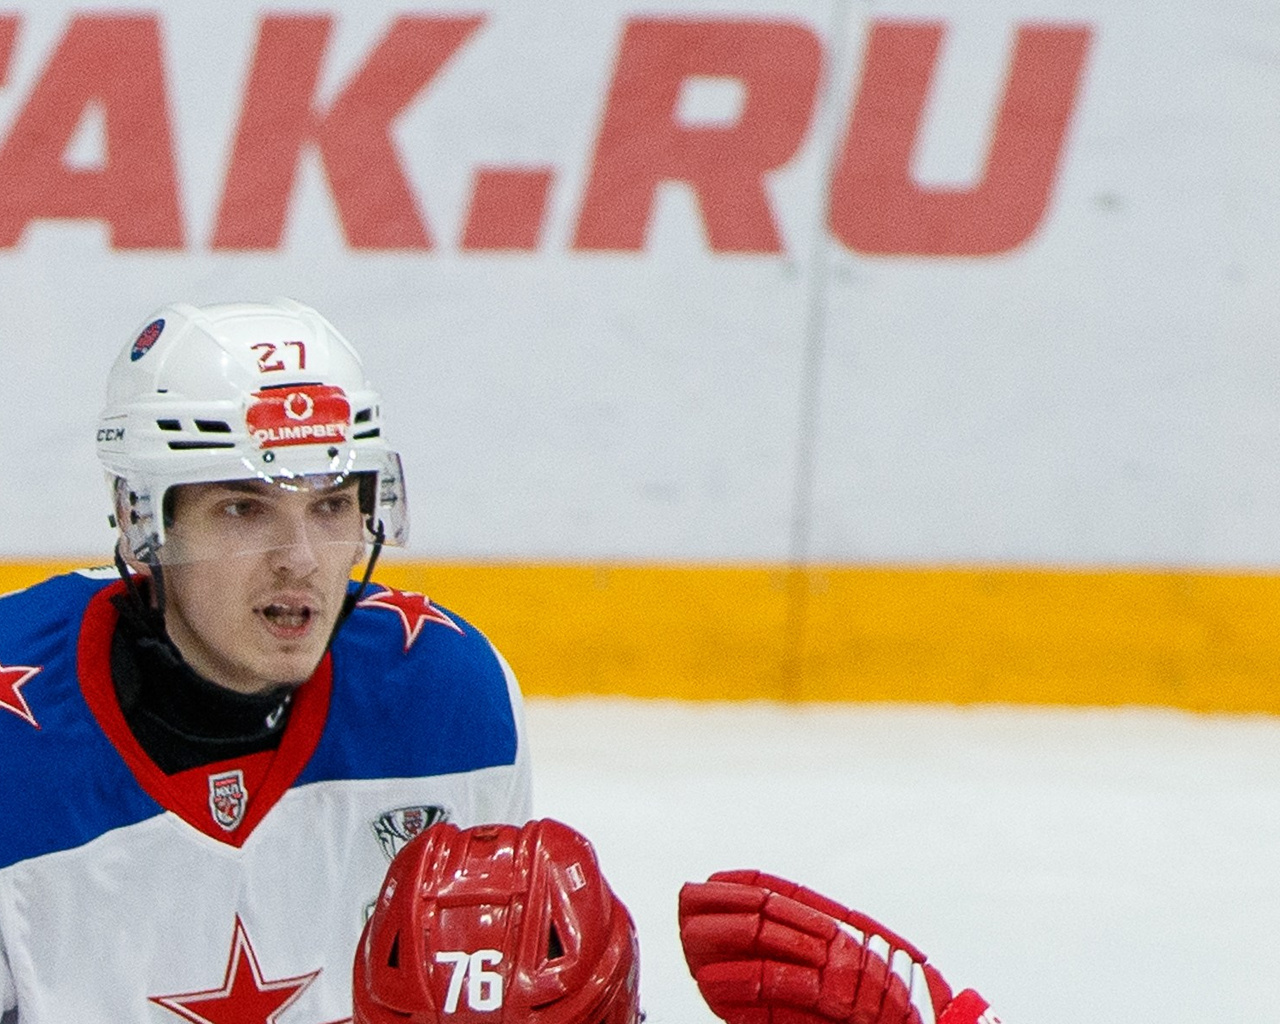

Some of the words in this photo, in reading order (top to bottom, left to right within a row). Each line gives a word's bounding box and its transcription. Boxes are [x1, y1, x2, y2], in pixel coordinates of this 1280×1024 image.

[251, 341, 306, 373] 27
[96, 428, 125, 442] CCM
[254, 424, 348, 443] OLIMPBET
[435, 949, 503, 1013] 76
